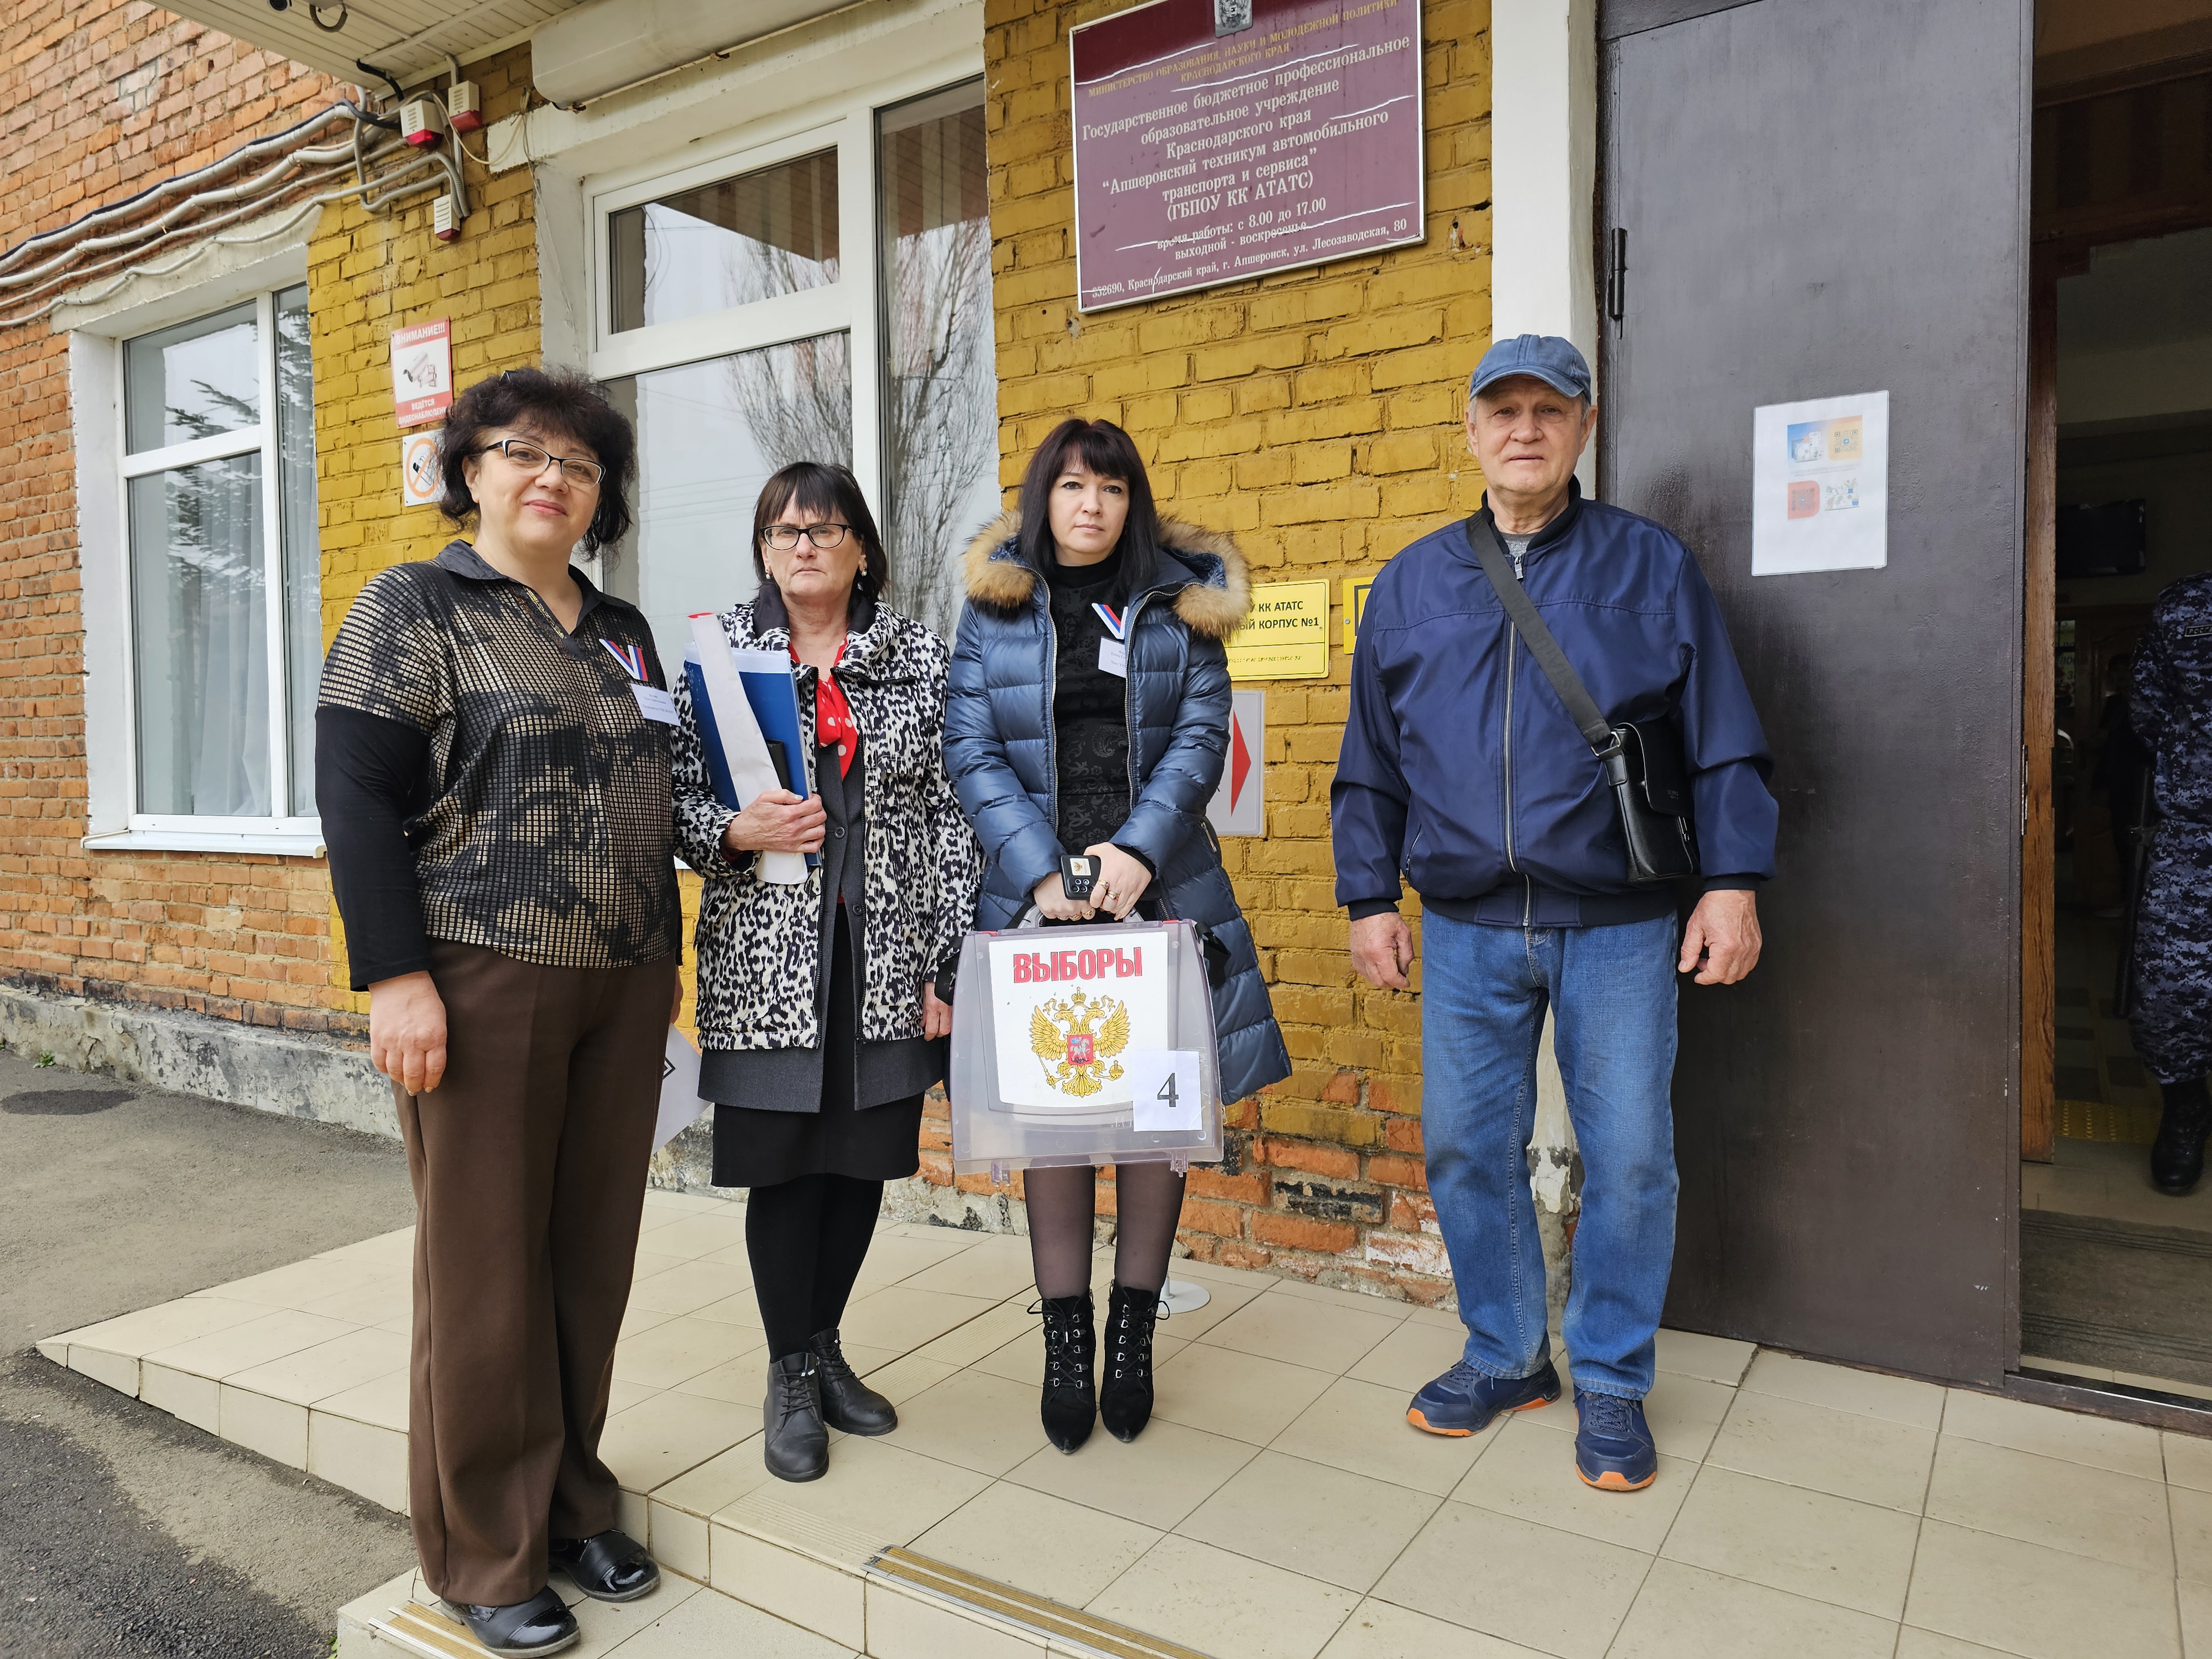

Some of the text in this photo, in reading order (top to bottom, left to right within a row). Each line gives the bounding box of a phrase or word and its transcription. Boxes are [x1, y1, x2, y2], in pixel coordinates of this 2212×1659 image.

[1089, 71, 1153, 98] МИНИСТЕРСТВО
[1225, 39, 1256, 57] НАУКИ
[1260, 36, 1266, 46] И
[1270, 13, 1339, 43] МОЛОДЕЖНОЙ
[1343, 0, 1397, 21] ПОЛИТИКИ
[1181, 43, 1289, 83] КРАСНОДАРСКОГО КРАЯ
[1082, 36, 1410, 141] Государственное бюджетное профессиональное
[1141, 79, 1339, 144] образовательное учреждение
[1166, 109, 1311, 160] Краснодарского края
[1202, 144, 1266, 170] техникум
[1272, 111, 1389, 152] автомобильного
[1162, 173, 1235, 204] транспорта
[1242, 170, 1249, 182] и
[1167, 170, 1313, 222] (ГБПОУ КК АТАТС)
[1157, 197, 1326, 251] время работы: с 8.00 до 17.00
[1175, 237, 1227, 260] выходной
[1240, 221, 1307, 246] воскресенье
[1128, 268, 1192, 290] Краснодарский
[1196, 262, 1219, 276] край,
[1223, 261, 1230, 270] г.
[1234, 249, 1290, 267] Апшеронск,
[1293, 244, 1308, 257] ул.
[1312, 226, 1389, 250] Лесозаводская,
[1394, 218, 1407, 232] 80
[397, 322, 445, 345] ВНИМАНИЕ!!!
[411, 399, 435, 411] ВЕДЁТСЯ
[1259, 603, 1271, 612] КК
[1274, 601, 1303, 611] АТАТС
[1259, 618, 1298, 629] КОРПУС
[1301, 617, 1319, 627] №1
[1014, 947, 1142, 983] ВЫБОРЫ
[1157, 1072, 1179, 1107] 4
